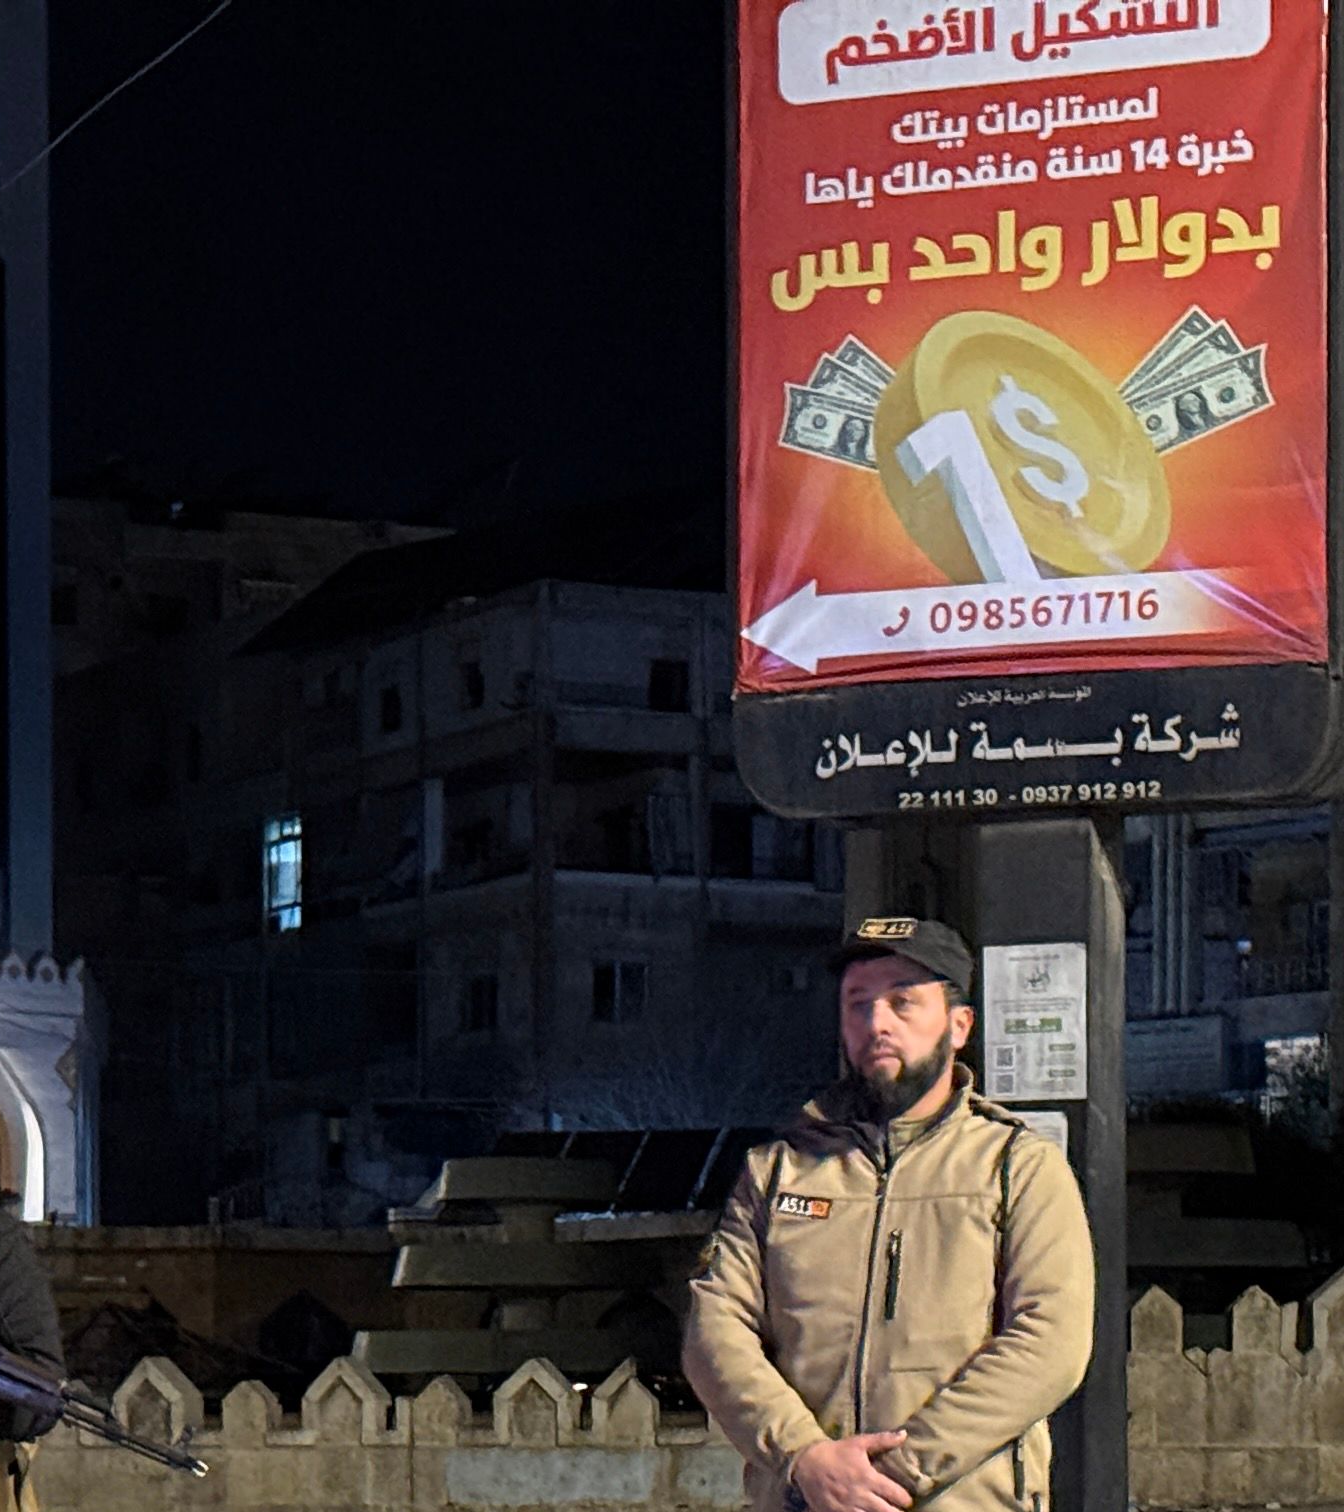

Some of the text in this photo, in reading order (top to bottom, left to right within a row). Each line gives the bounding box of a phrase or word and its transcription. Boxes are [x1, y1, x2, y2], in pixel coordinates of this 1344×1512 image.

[825, 5, 995, 85] الأضخم
[891, 86, 1159, 150] لمستلزمات بيتك
[805, 129, 1254, 208] خبرة 14 سنة منقدملك ياها
[770, 195, 1282, 313] بدولار واحد بس
[930, 588, 1160, 634] 0985671716
[814, 703, 1240, 779] شركة بسمة للإعلان
[898, 791, 924, 809] 22
[930, 790, 968, 808] 111
[971, 788, 998, 806] 30
[1022, 784, 1073, 804] 0937
[1078, 782, 1118, 801] 912
[1122, 780, 1162, 800] 912
